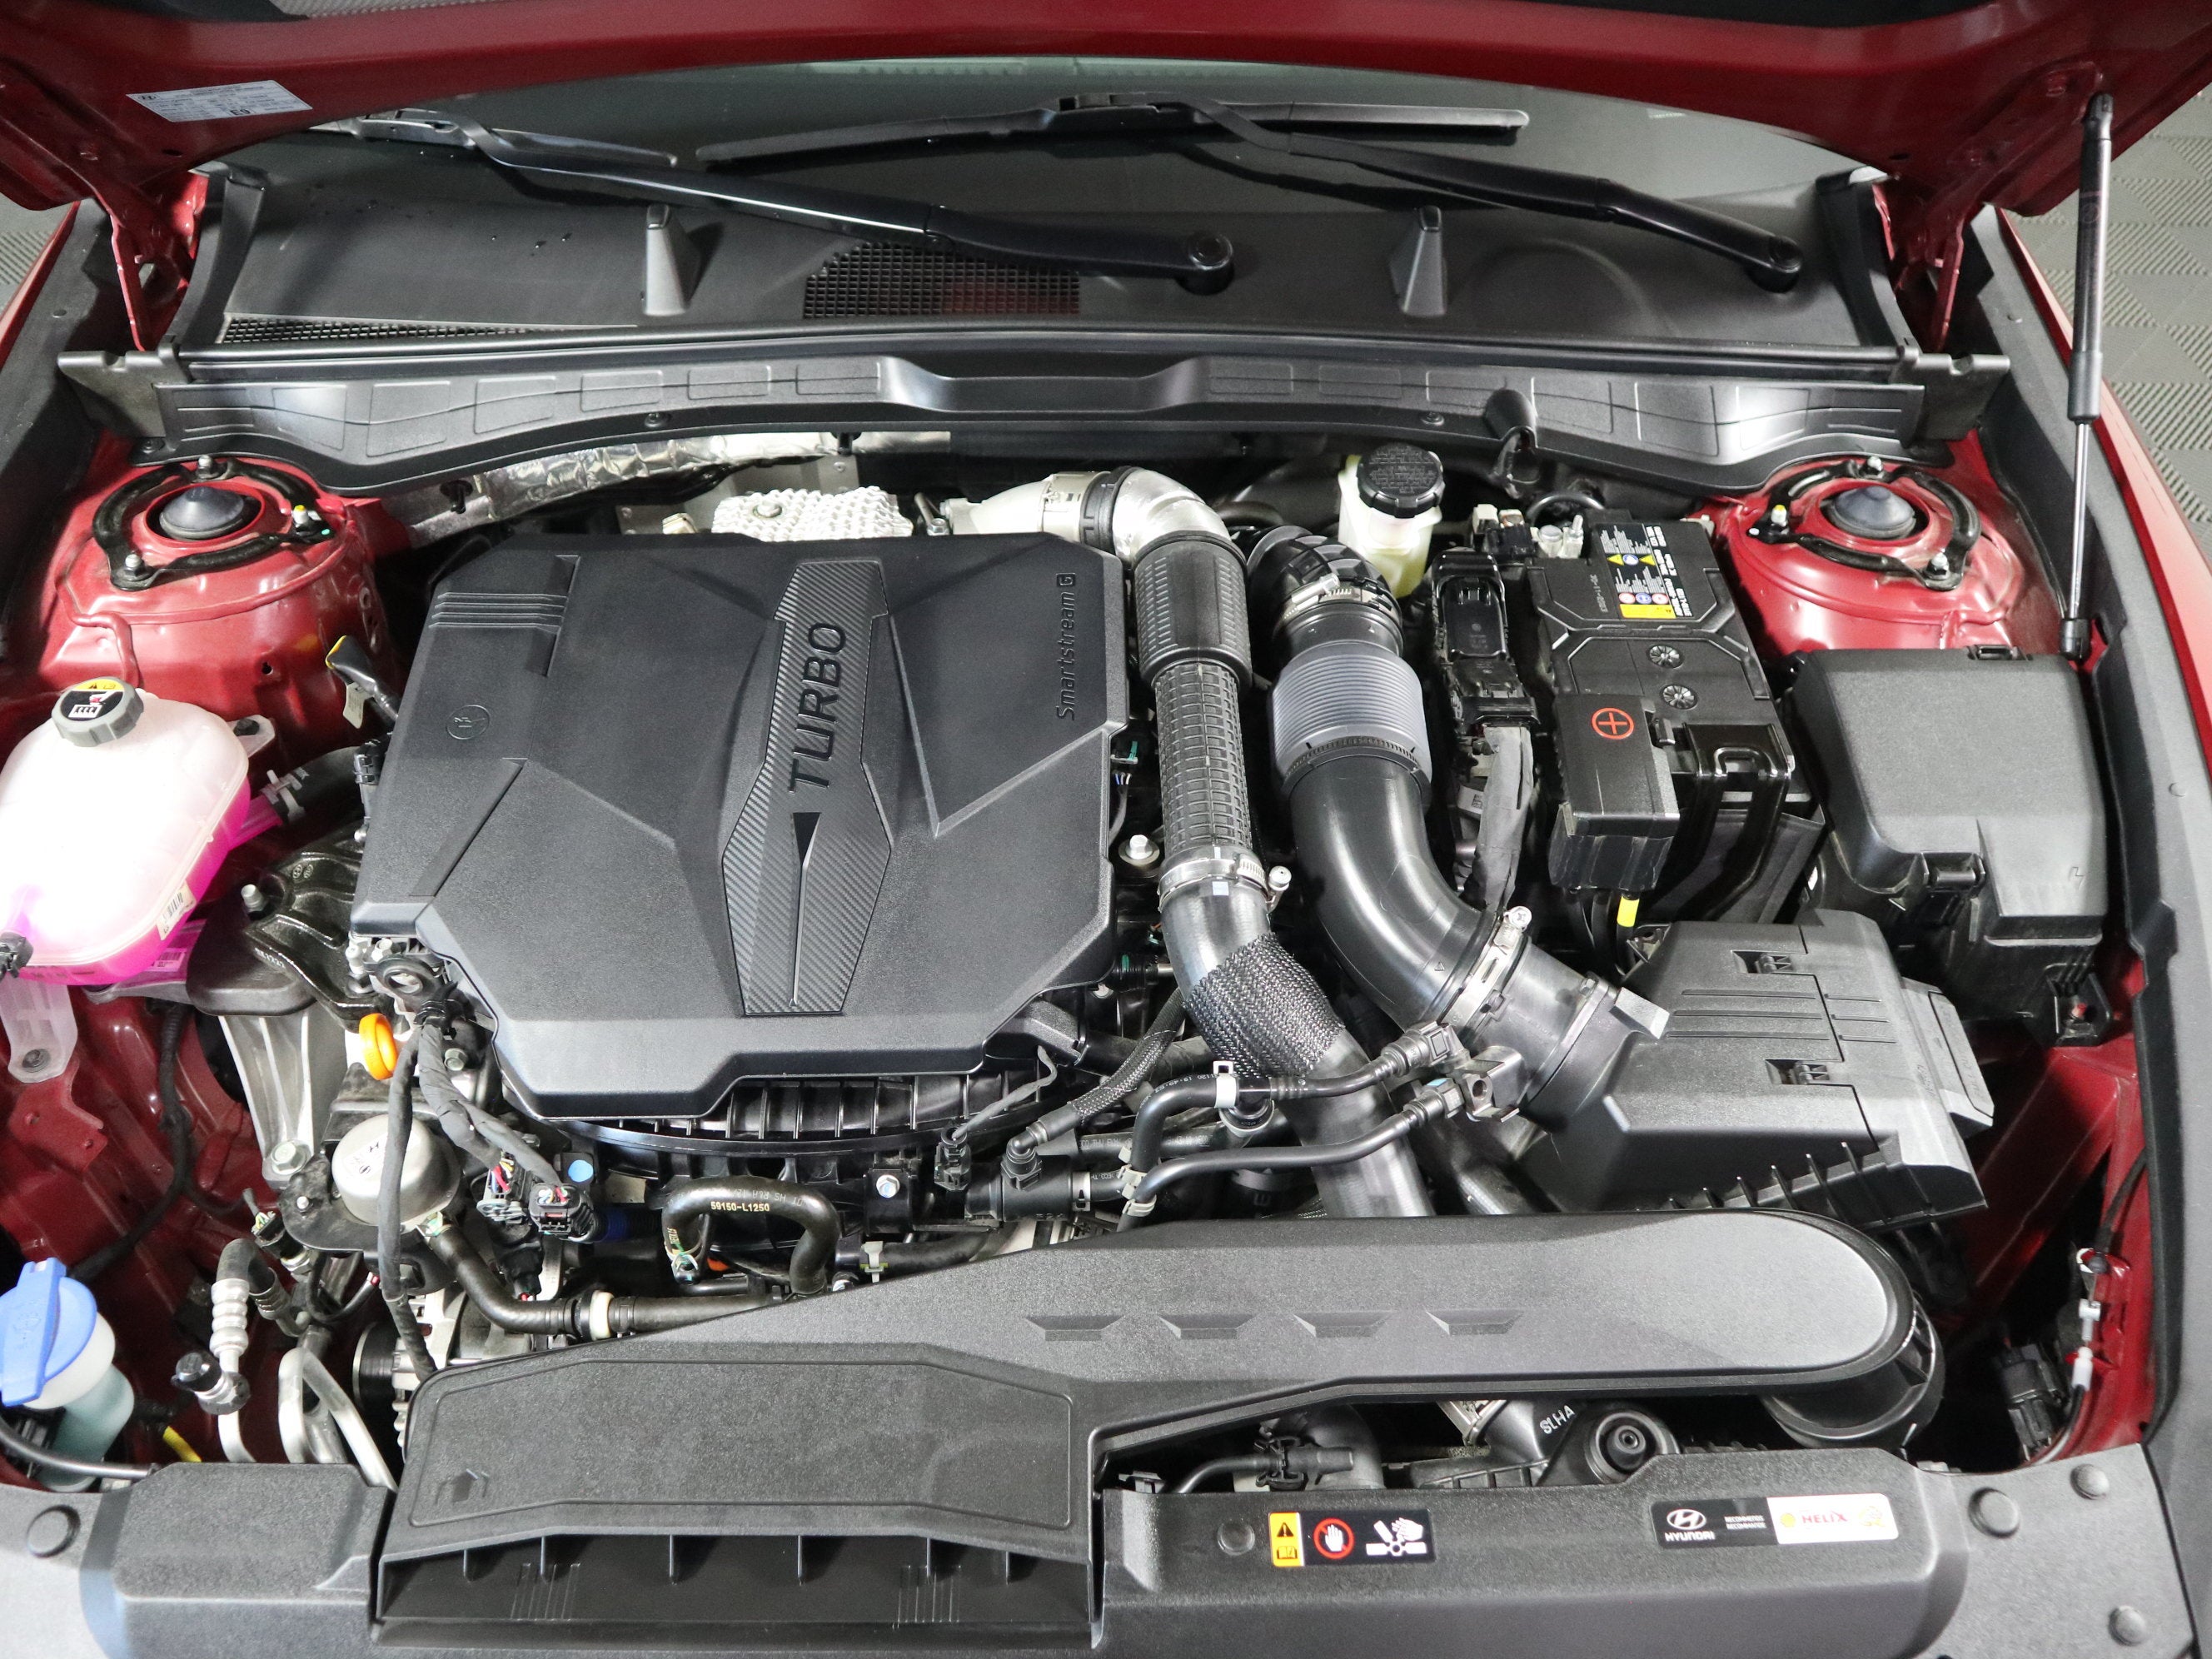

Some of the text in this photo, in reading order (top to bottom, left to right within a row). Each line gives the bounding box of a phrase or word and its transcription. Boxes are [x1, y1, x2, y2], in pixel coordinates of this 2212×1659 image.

[1057, 591, 1075, 721] Smartstream
[788, 622, 846, 794] TURBO
[710, 1201, 770, 1212] 59150-L1250
[1540, 1405, 1575, 1434] SLHA
[1801, 1512, 1848, 1523] HELIX
[1665, 1531, 1716, 1542] HYUNDAI
